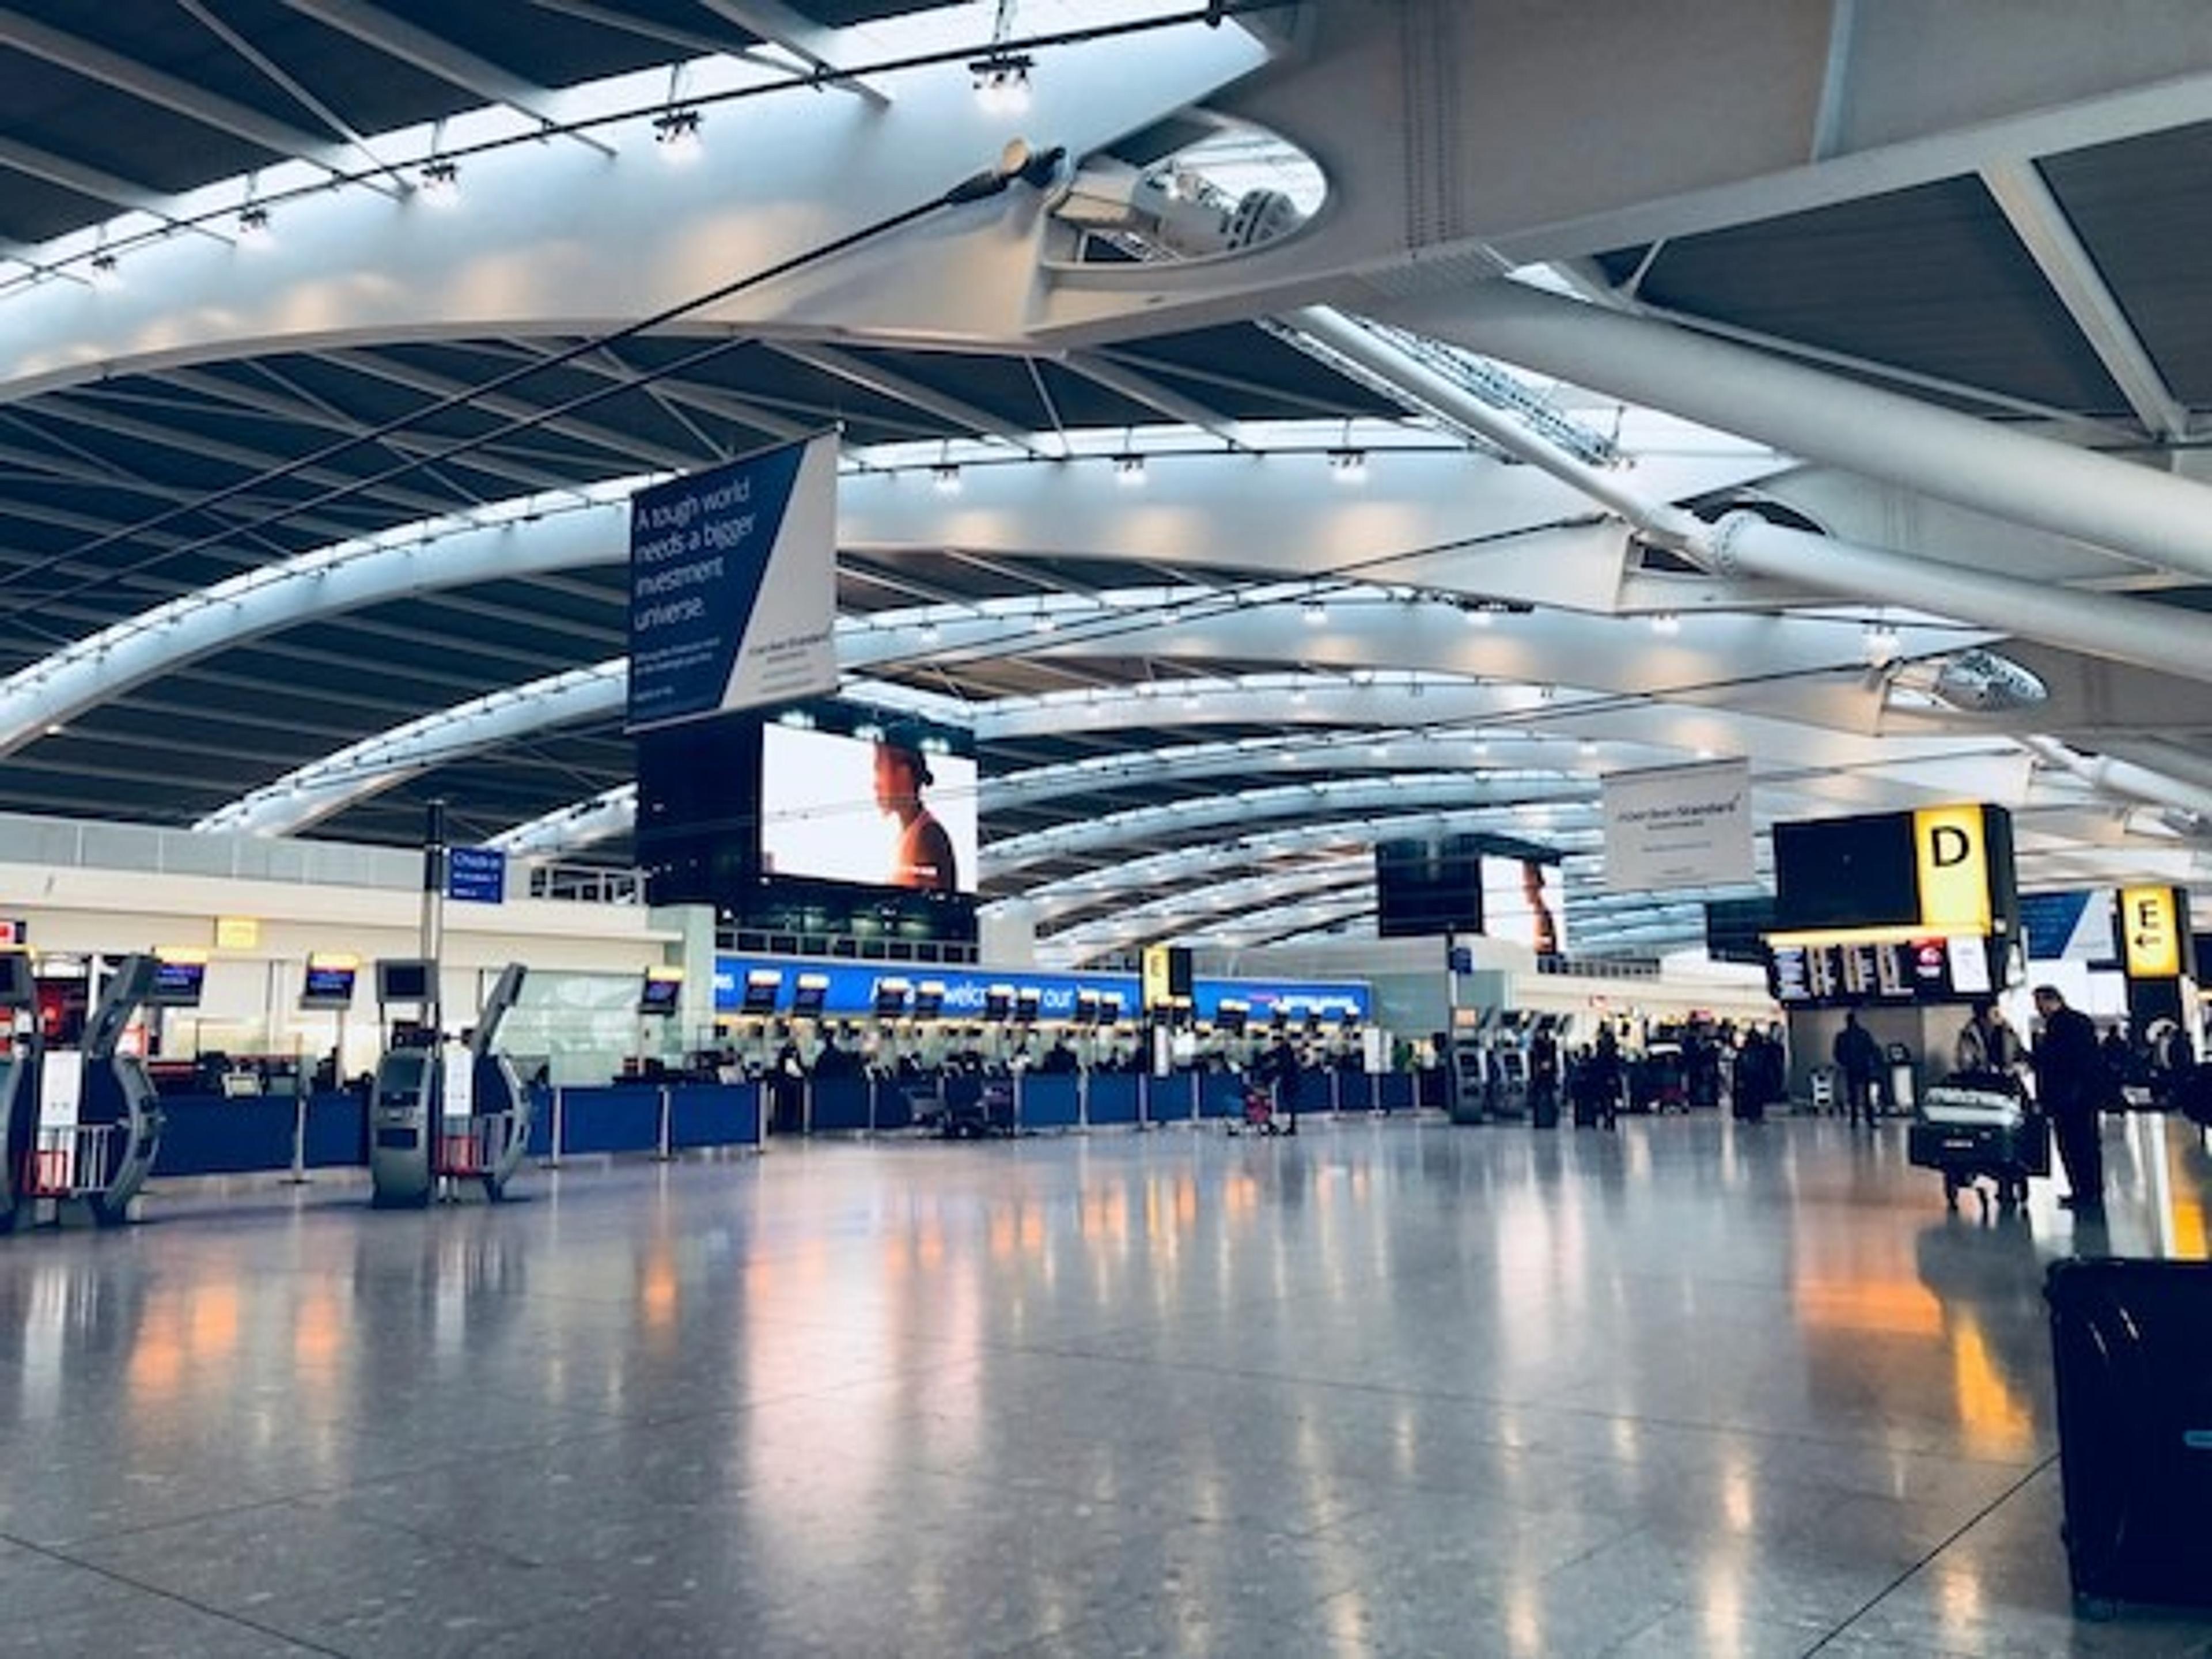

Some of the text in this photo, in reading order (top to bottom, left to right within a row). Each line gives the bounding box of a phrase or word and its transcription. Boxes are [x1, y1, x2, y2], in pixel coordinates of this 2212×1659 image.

[635, 475, 751, 531] A tough world
[635, 512, 757, 563] needs a bigger
[1930, 825, 1969, 868] D
[2137, 899, 2160, 929] E
[1043, 987, 1074, 1007] our
